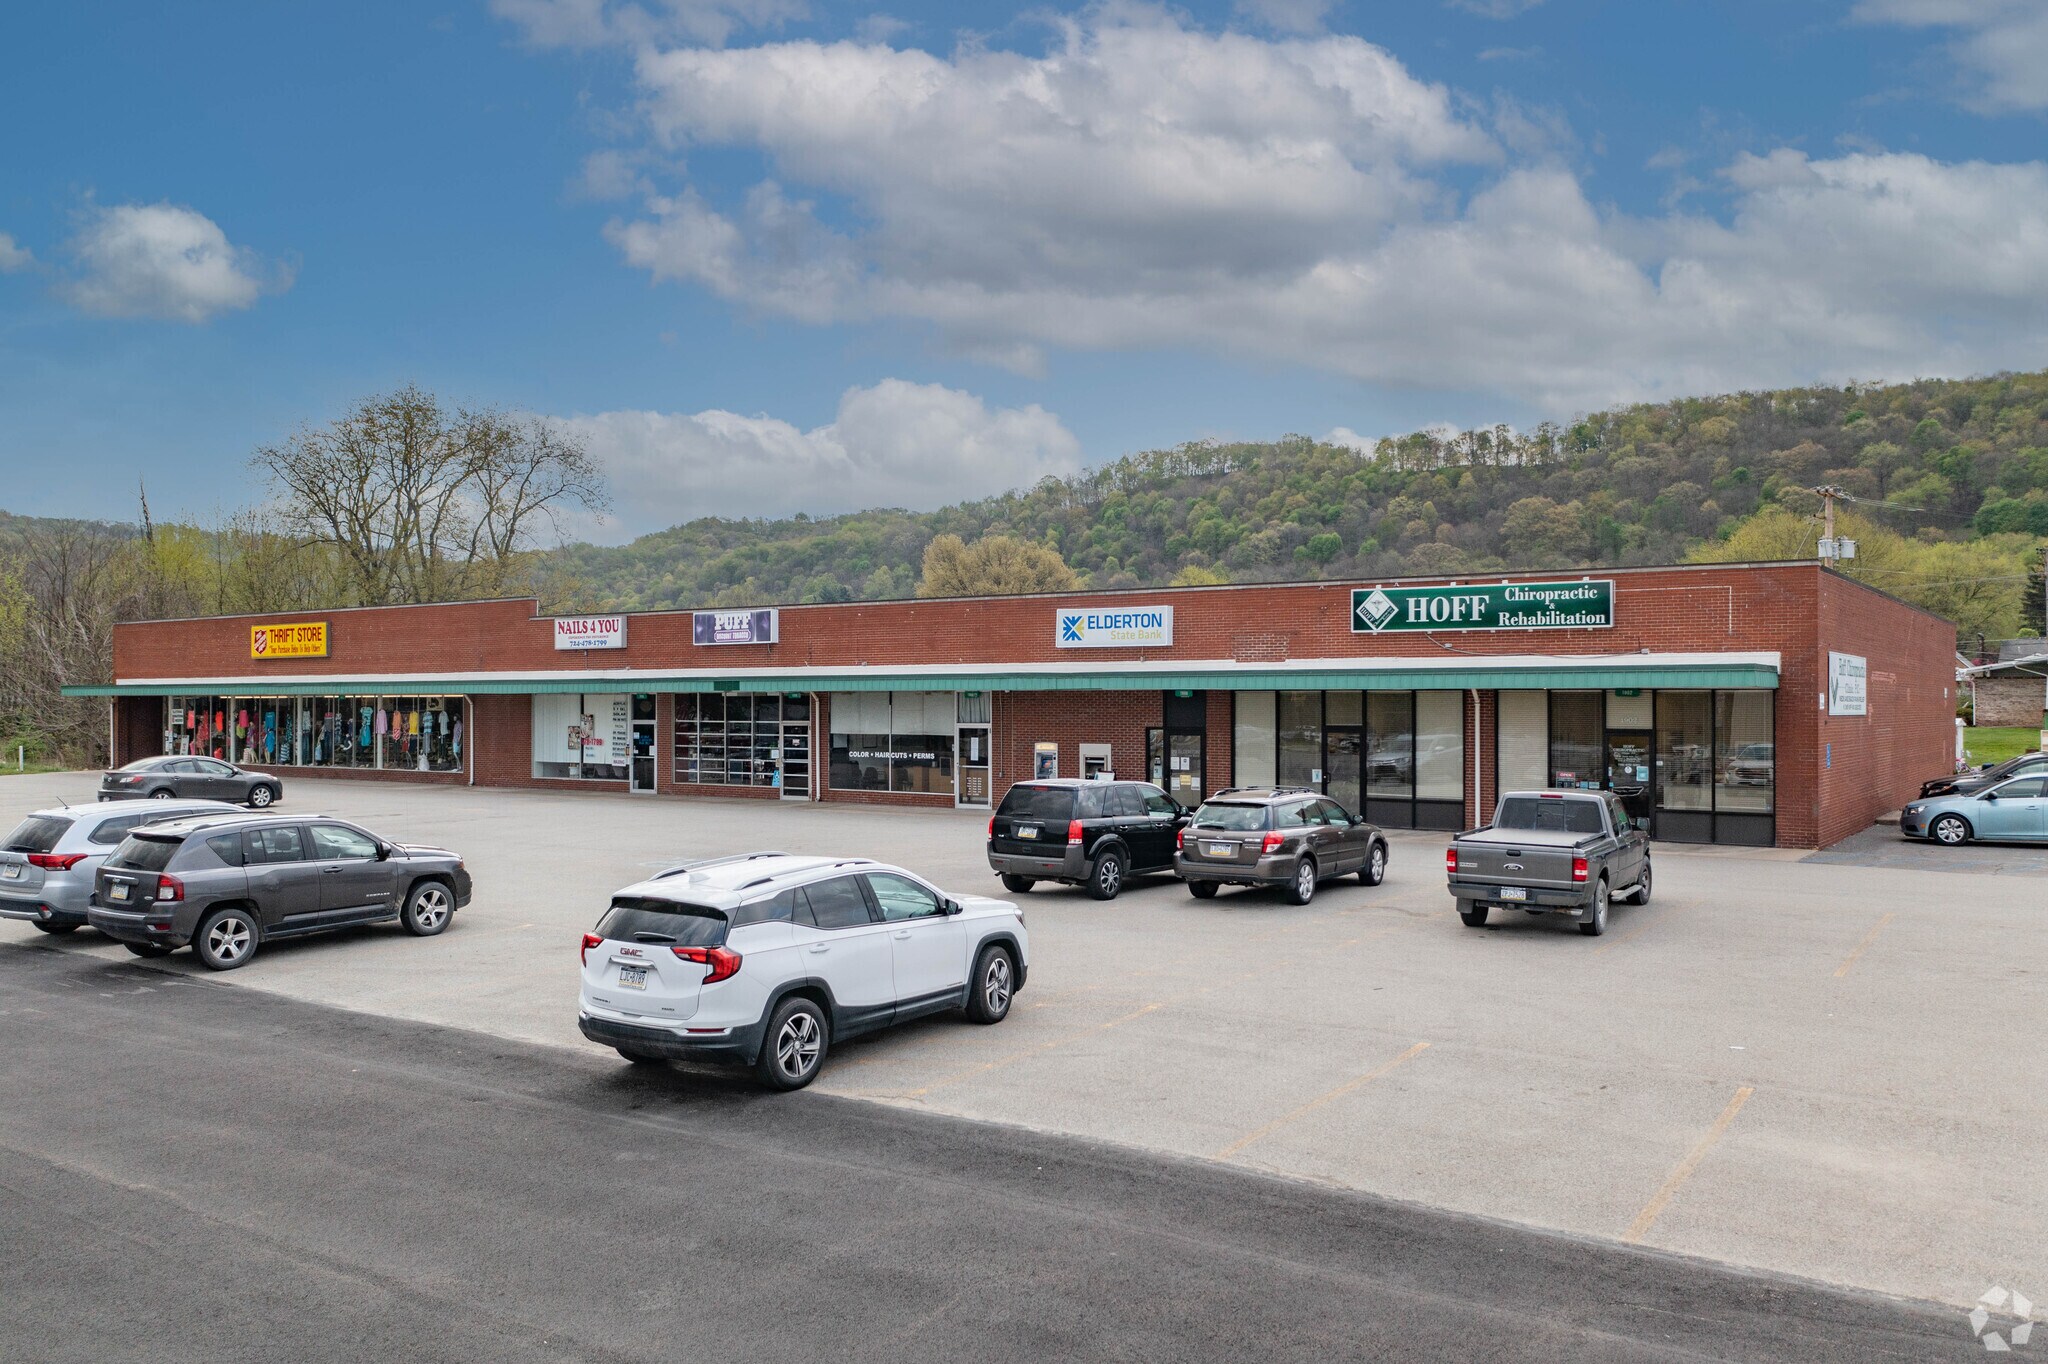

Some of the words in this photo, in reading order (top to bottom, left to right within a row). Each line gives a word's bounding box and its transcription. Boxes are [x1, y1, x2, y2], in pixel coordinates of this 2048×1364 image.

[1504, 585, 1598, 604] Chiropractic
[1405, 595, 1490, 623] HOFF
[558, 620, 588, 635] NAILS
[590, 620, 597, 634] 4
[598, 619, 620, 633] YOU
[714, 612, 752, 630] PUFF
[1087, 613, 1162, 630] ELDERTON
[1498, 610, 1606, 627] Rehabilitation
[269, 628, 295, 643] THRIFT
[297, 626, 322, 643] STORE
[1110, 630, 1136, 640] State
[1138, 629, 1162, 640] Bank
[620, 947, 643, 958] GMC
